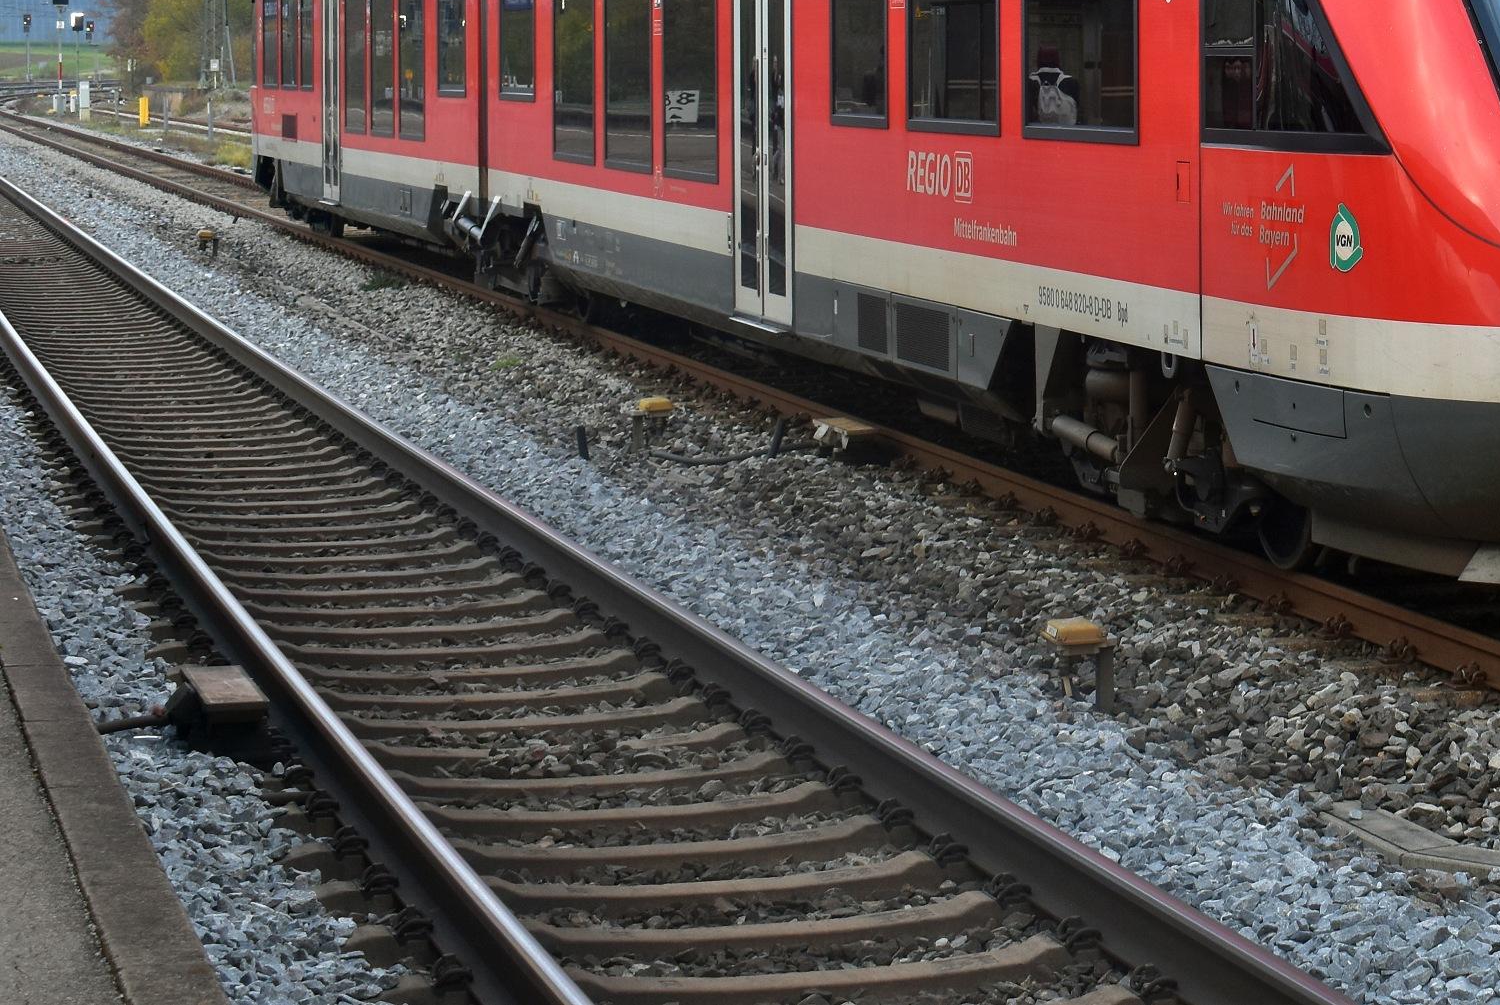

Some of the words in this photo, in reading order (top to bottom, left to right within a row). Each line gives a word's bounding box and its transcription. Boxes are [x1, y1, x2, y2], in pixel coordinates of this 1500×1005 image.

[907, 150, 951, 197] REGIO
[956, 158, 972, 197] DB
[1222, 202, 1233, 216] Wir
[1233, 203, 1254, 218] fahren
[1260, 200, 1305, 223] Bahnland
[953, 217, 1017, 246] Mittelfrankenbahn
[1241, 222, 1253, 237] das
[1259, 224, 1290, 248] Bayern
[1336, 233, 1353, 247] VGN
